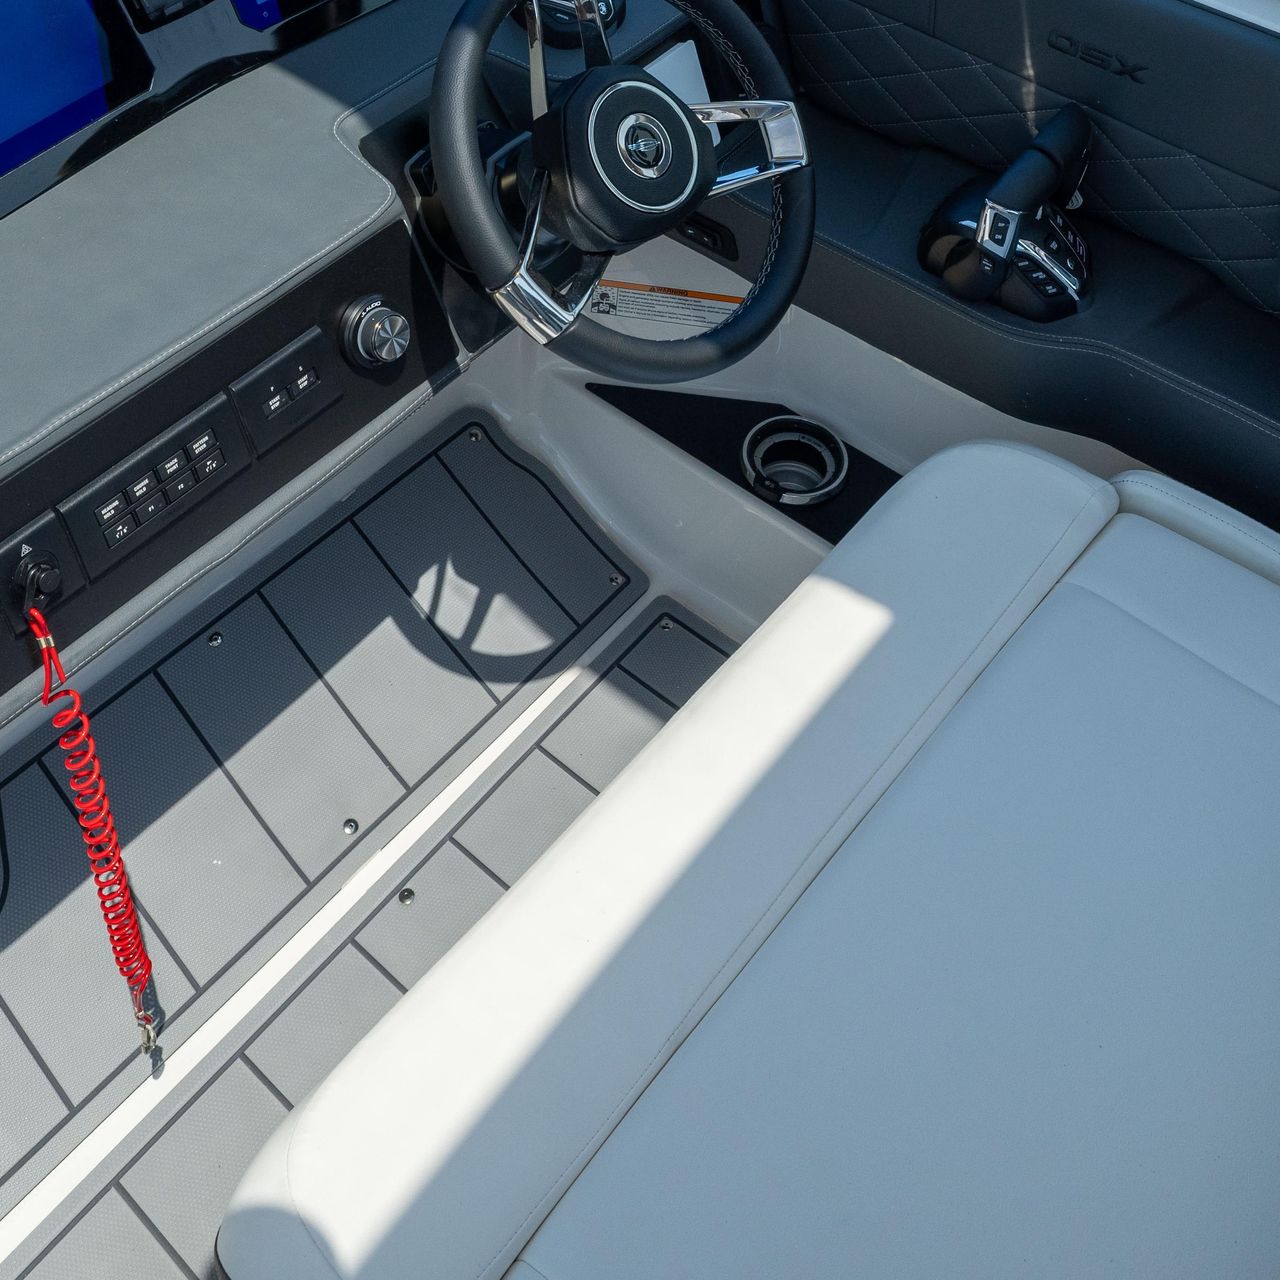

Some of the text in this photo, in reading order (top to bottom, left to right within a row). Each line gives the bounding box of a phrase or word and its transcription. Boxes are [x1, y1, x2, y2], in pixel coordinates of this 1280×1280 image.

[365, 301, 381, 312] AUDIO
[298, 374, 308, 385] START
[299, 380, 308, 389] STOP
[269, 395, 280, 406] START
[271, 401, 280, 410] STOP
[136, 487, 146, 497] HOLD
[104, 510, 114, 519] HOLD
